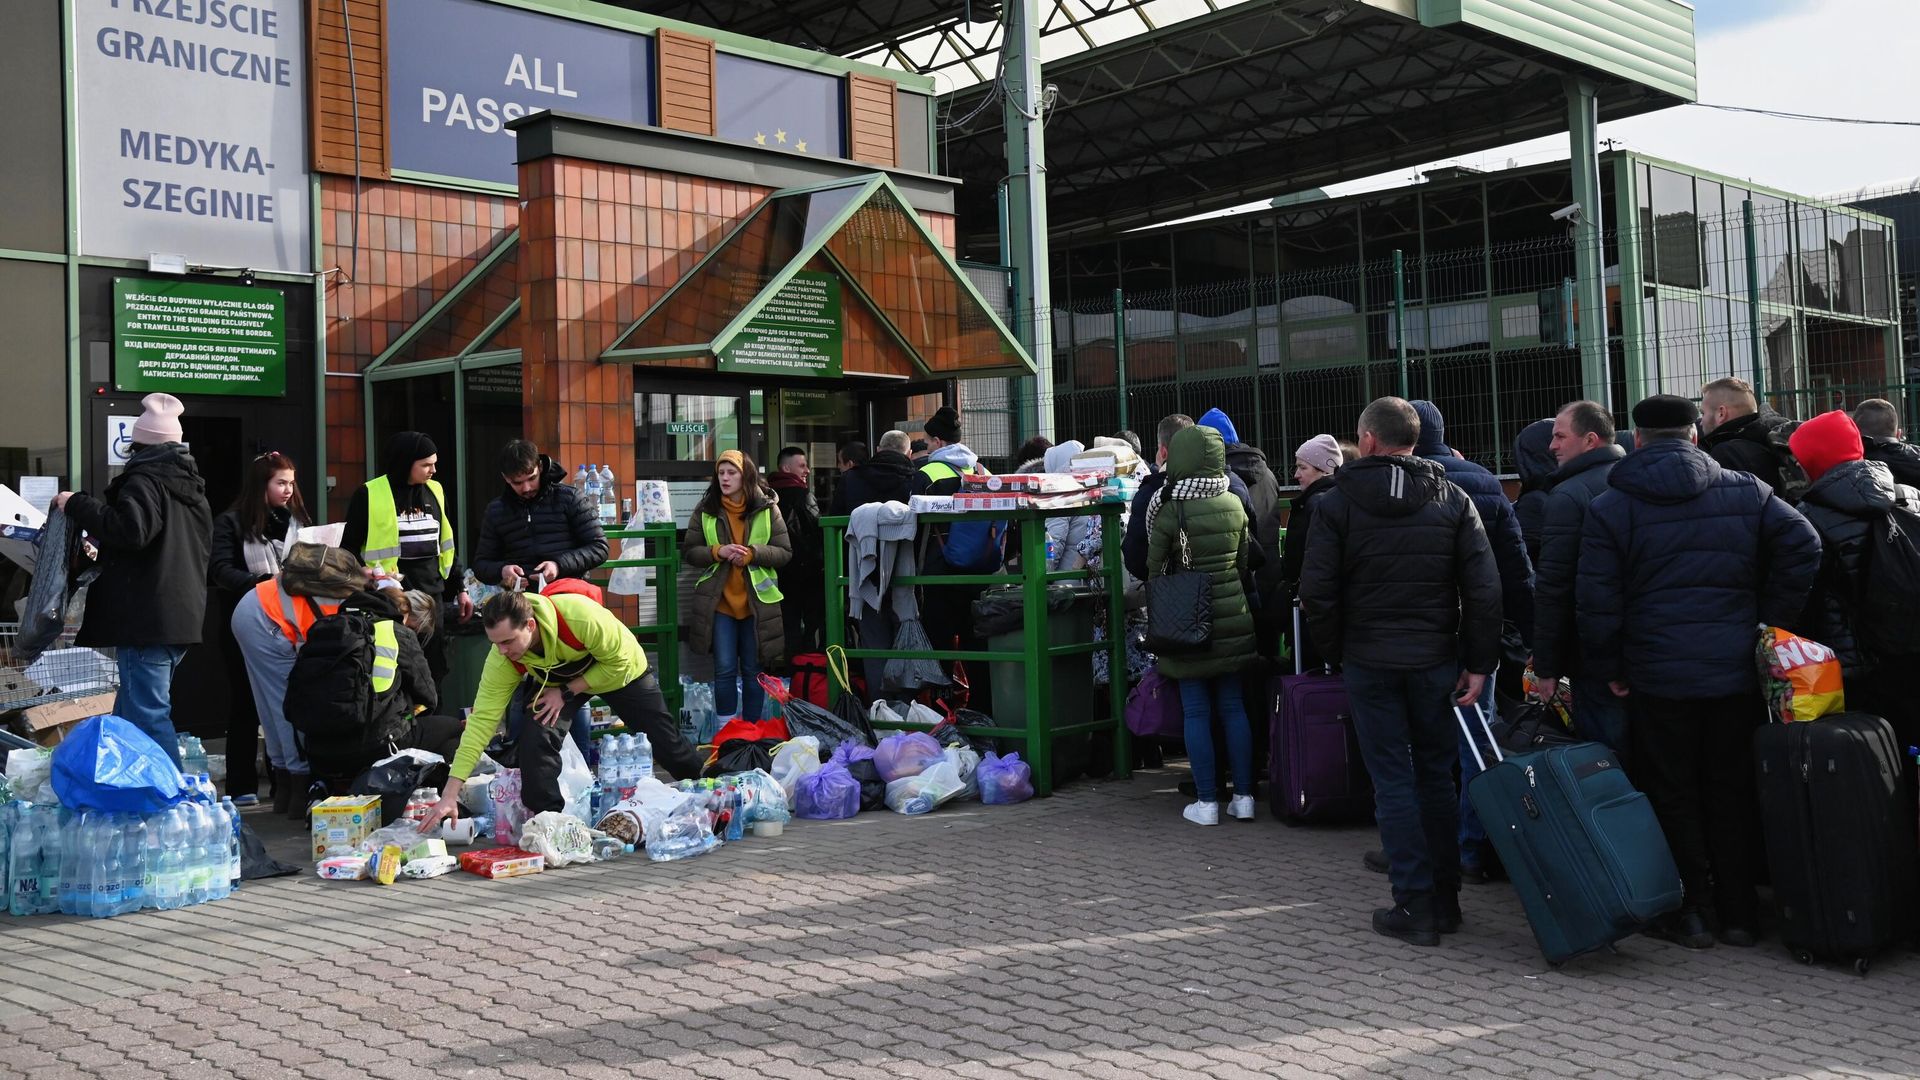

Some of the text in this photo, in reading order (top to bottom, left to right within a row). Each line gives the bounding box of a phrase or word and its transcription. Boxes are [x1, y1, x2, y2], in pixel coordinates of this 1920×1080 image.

[96, 26, 291, 88] GRANICZNE
[504, 54, 578, 98] ALL
[422, 88, 546, 138] PASS
[120, 128, 275, 176] MEDYKA-
[122, 178, 274, 223] SZEGINIE
[124, 293, 156, 302] WEJŚCIE
[169, 297, 202, 305] BUDYNKU
[257, 302, 274, 310] OSÓB
[221, 319, 264, 327] EXCLUSIVELY
[124, 341, 142, 349] ВХІД
[228, 347, 276, 355] ПЕРЕТИНАЮТЬ
[672, 424, 704, 432] WEJŚCIE
